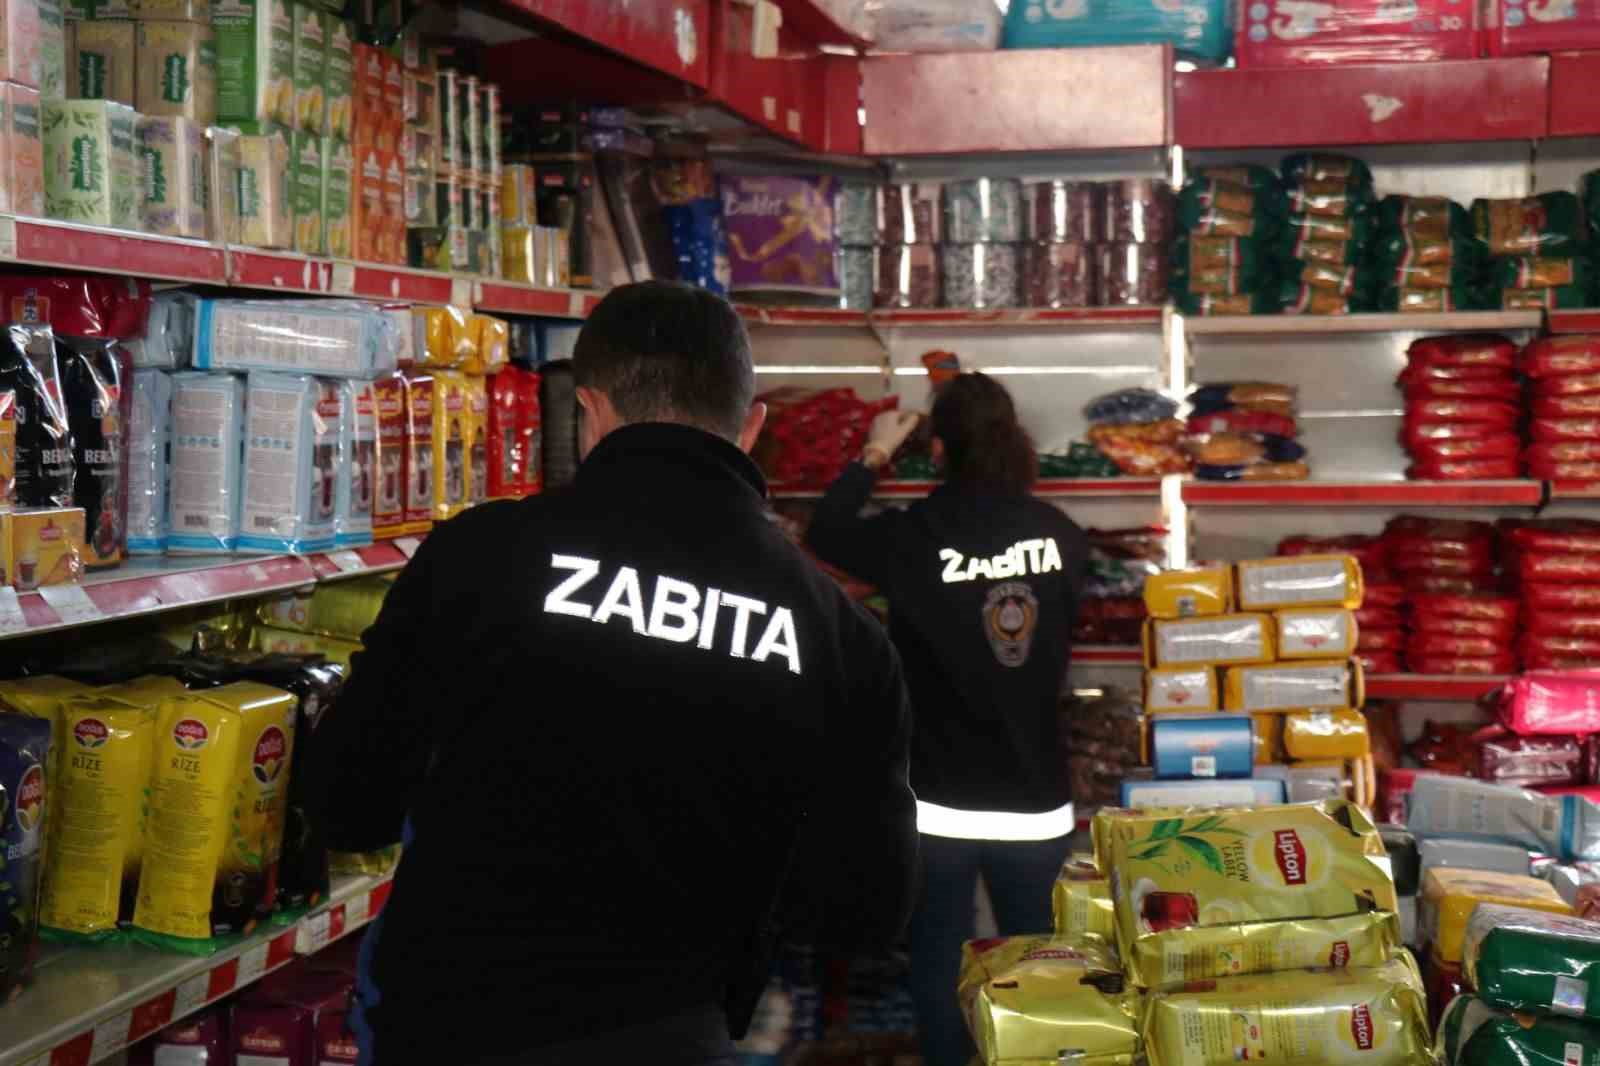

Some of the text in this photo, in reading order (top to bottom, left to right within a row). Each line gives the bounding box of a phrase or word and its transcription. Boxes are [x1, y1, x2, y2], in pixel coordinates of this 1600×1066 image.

[938, 536, 1063, 584] ZABITA
[542, 552, 802, 675] ZABITA
[1221, 846, 1237, 879] LABEL
[1231, 839, 1250, 882] YELLOW
[1277, 832, 1302, 881] Lipton
[1354, 1005, 1370, 1048] Lipton
